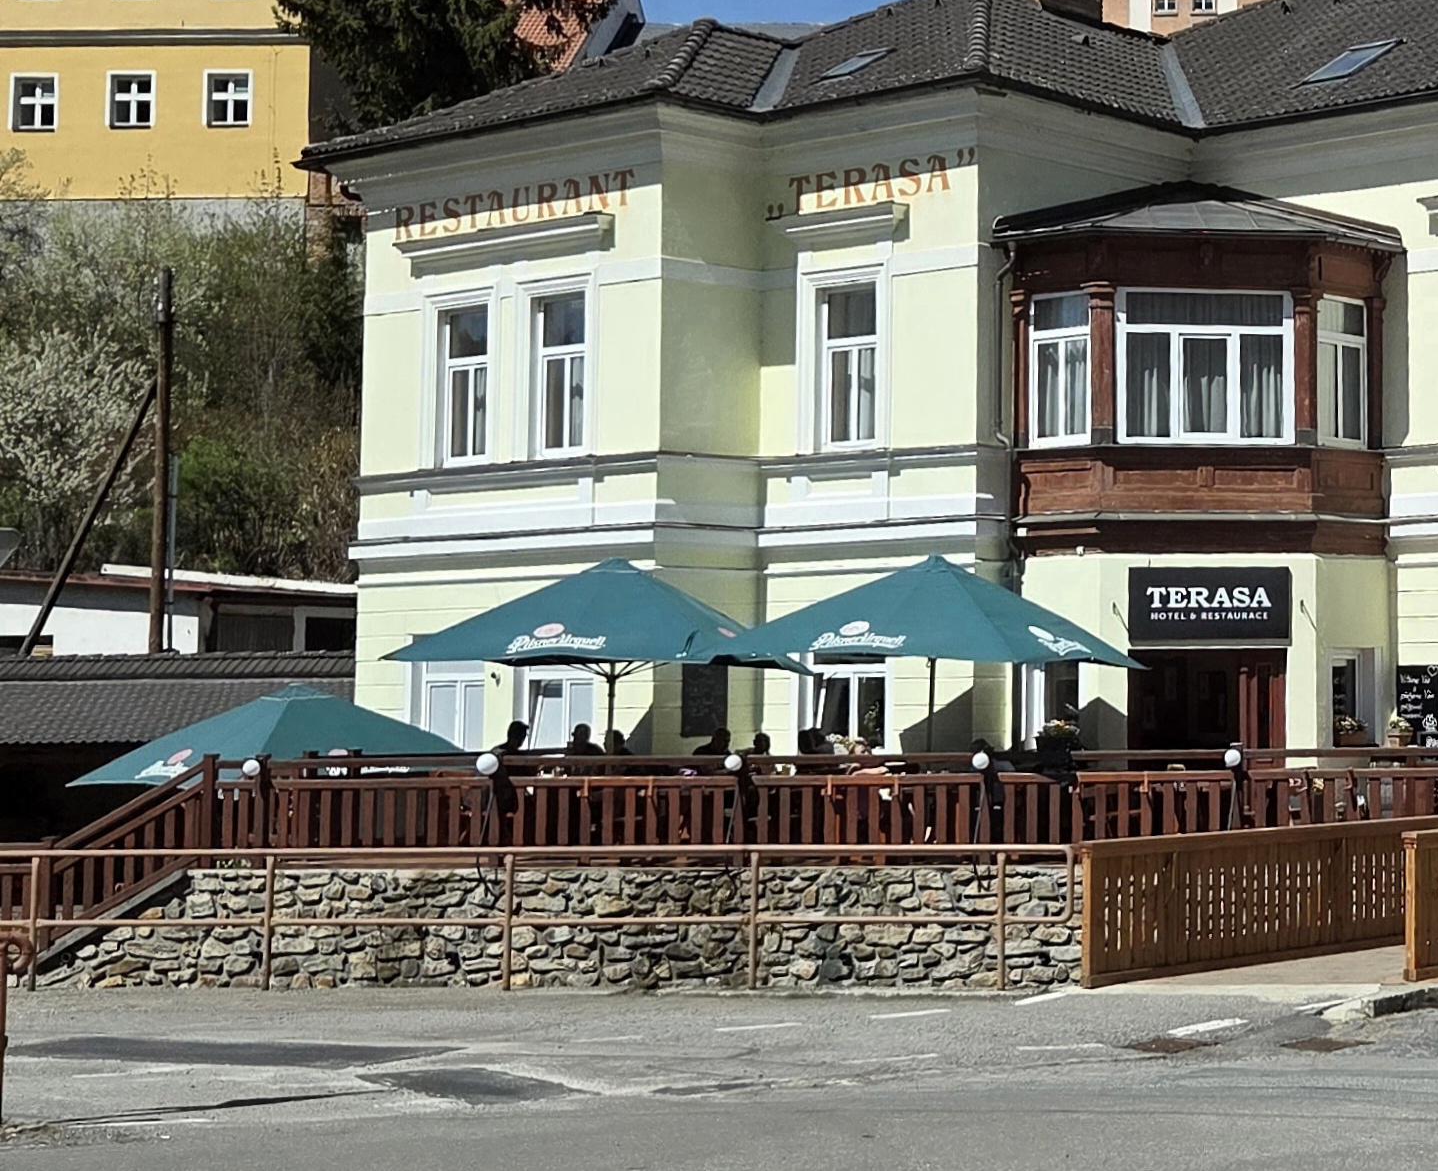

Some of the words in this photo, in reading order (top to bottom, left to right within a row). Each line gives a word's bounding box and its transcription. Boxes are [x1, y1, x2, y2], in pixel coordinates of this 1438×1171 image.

[394, 168, 636, 241] RESTAURANT
[1146, 586, 1272, 608] TERASA
[1150, 612, 1187, 620] HOTEL
[1190, 612, 1197, 620] &
[1201, 611, 1268, 620] RESTAURACE
